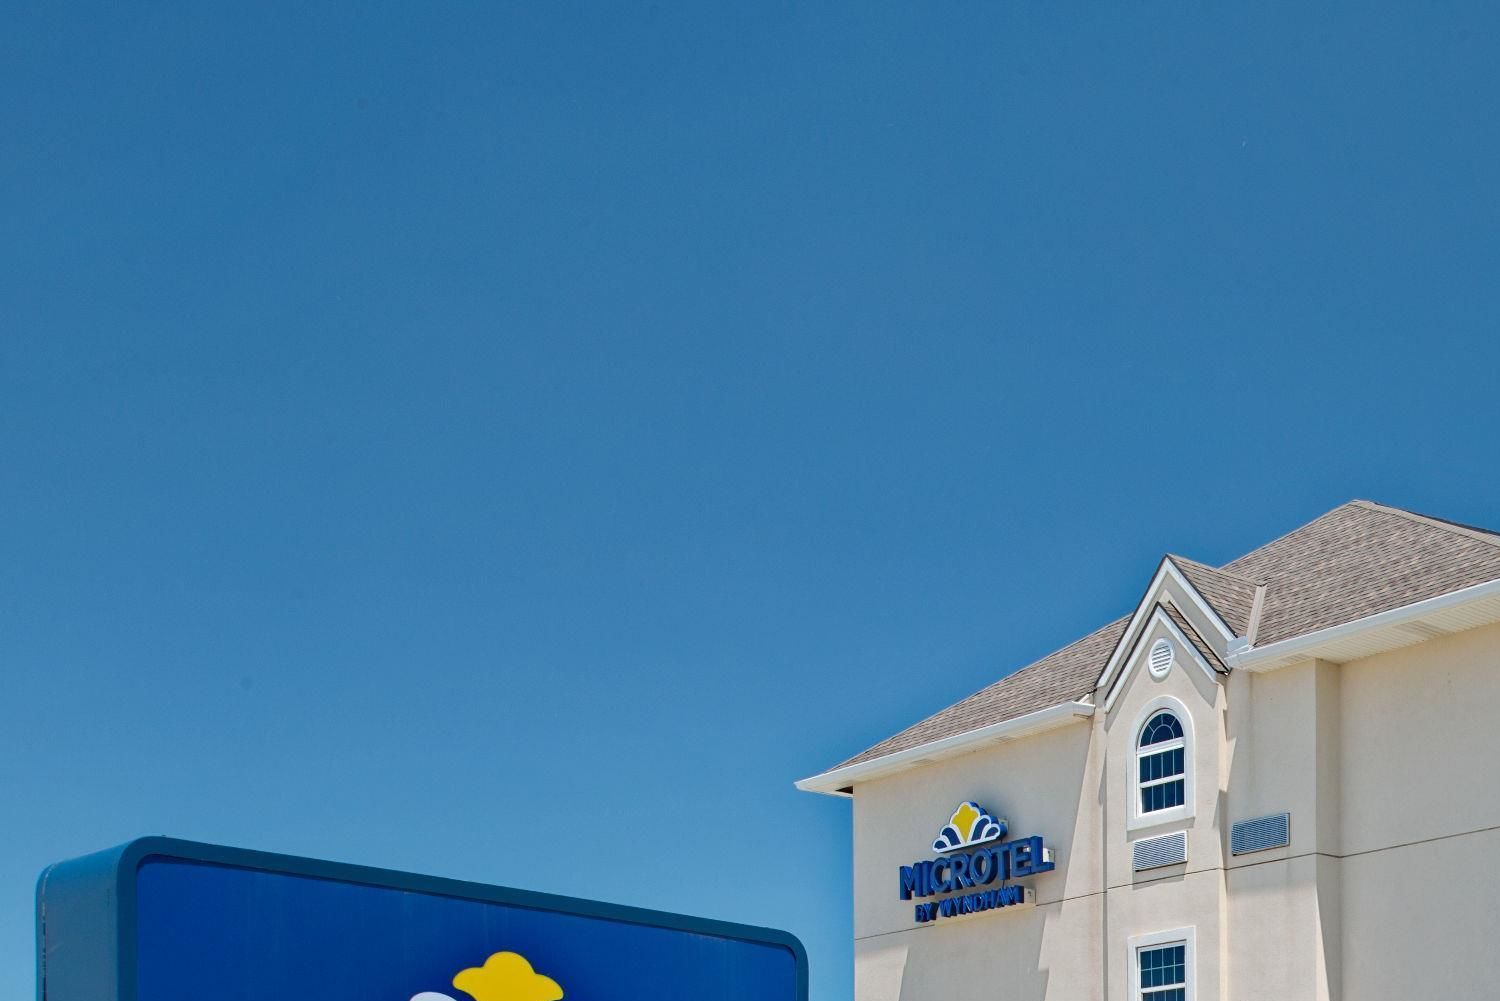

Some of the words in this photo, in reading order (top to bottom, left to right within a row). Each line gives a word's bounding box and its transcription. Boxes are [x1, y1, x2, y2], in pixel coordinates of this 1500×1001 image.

[899, 836, 1055, 900] MICROTEL
[915, 902, 938, 923] BY
[939, 885, 1025, 918] WYNDHAM
